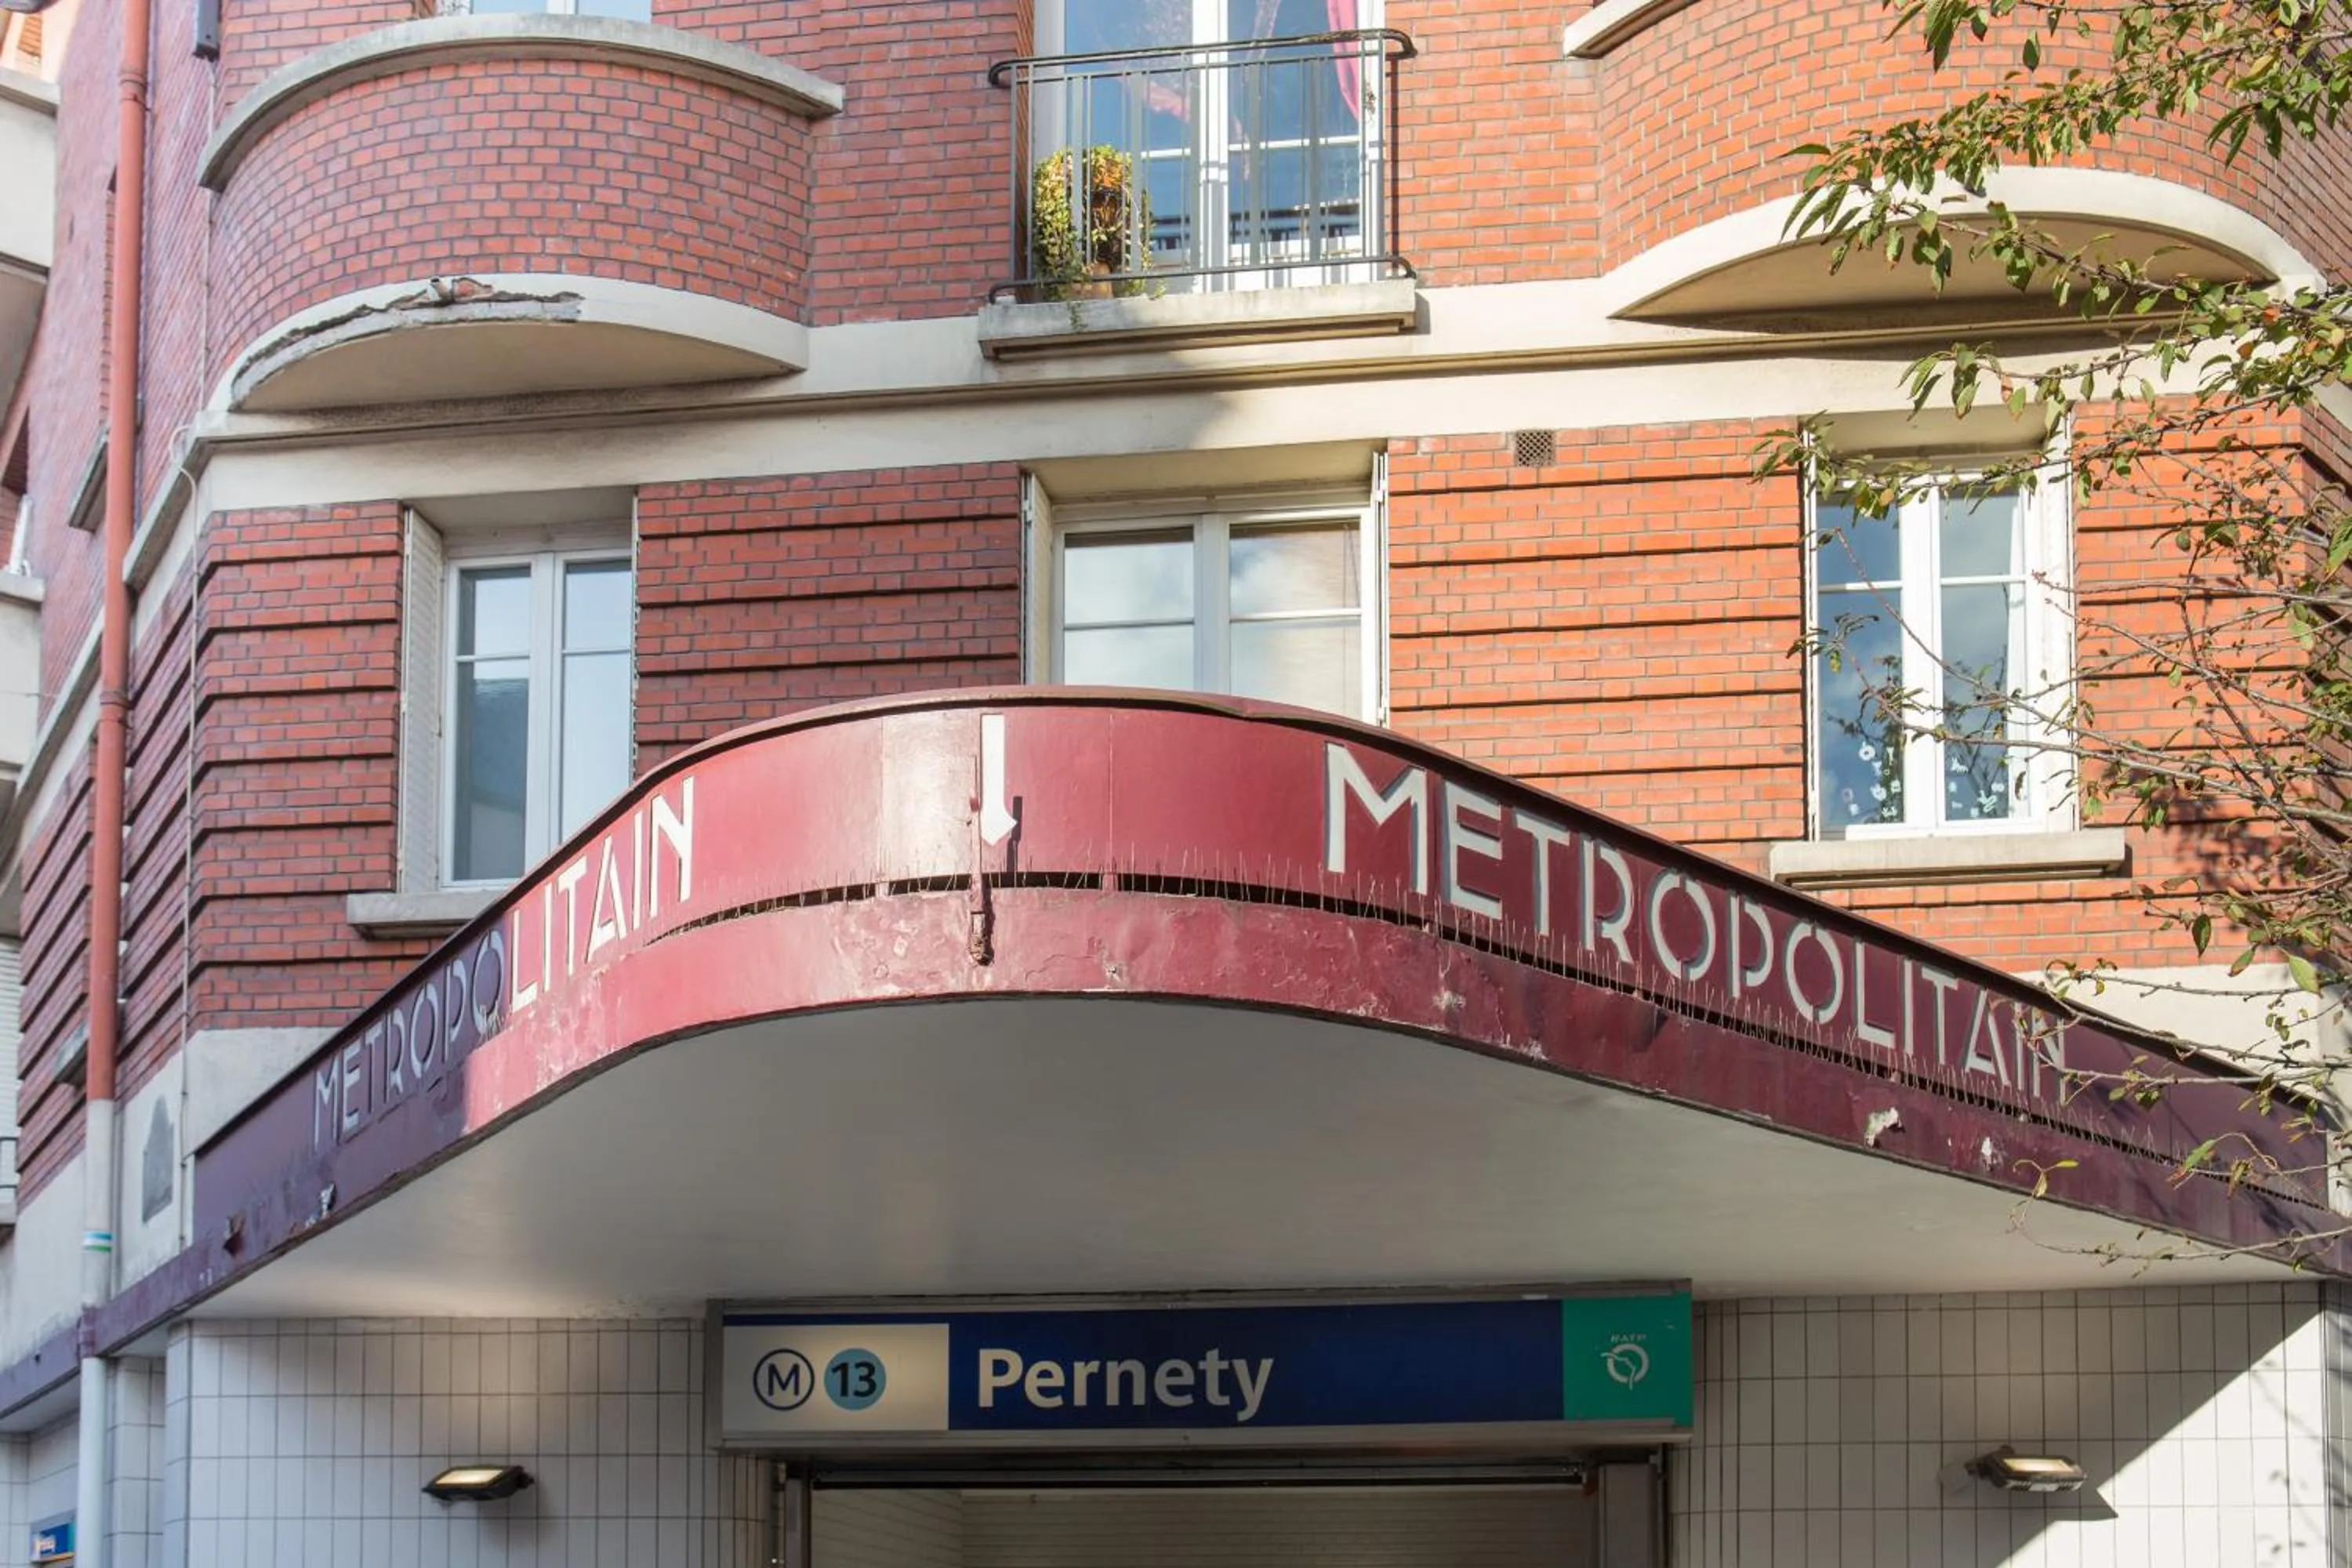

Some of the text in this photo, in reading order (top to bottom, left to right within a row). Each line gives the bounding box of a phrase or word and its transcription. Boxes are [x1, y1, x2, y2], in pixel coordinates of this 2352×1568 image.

[314, 776, 695, 1144] METROPOLITAIN
[1325, 742, 2067, 1104] METROPOLITAIN
[768, 1348, 1274, 1421] M 13 Pernety
